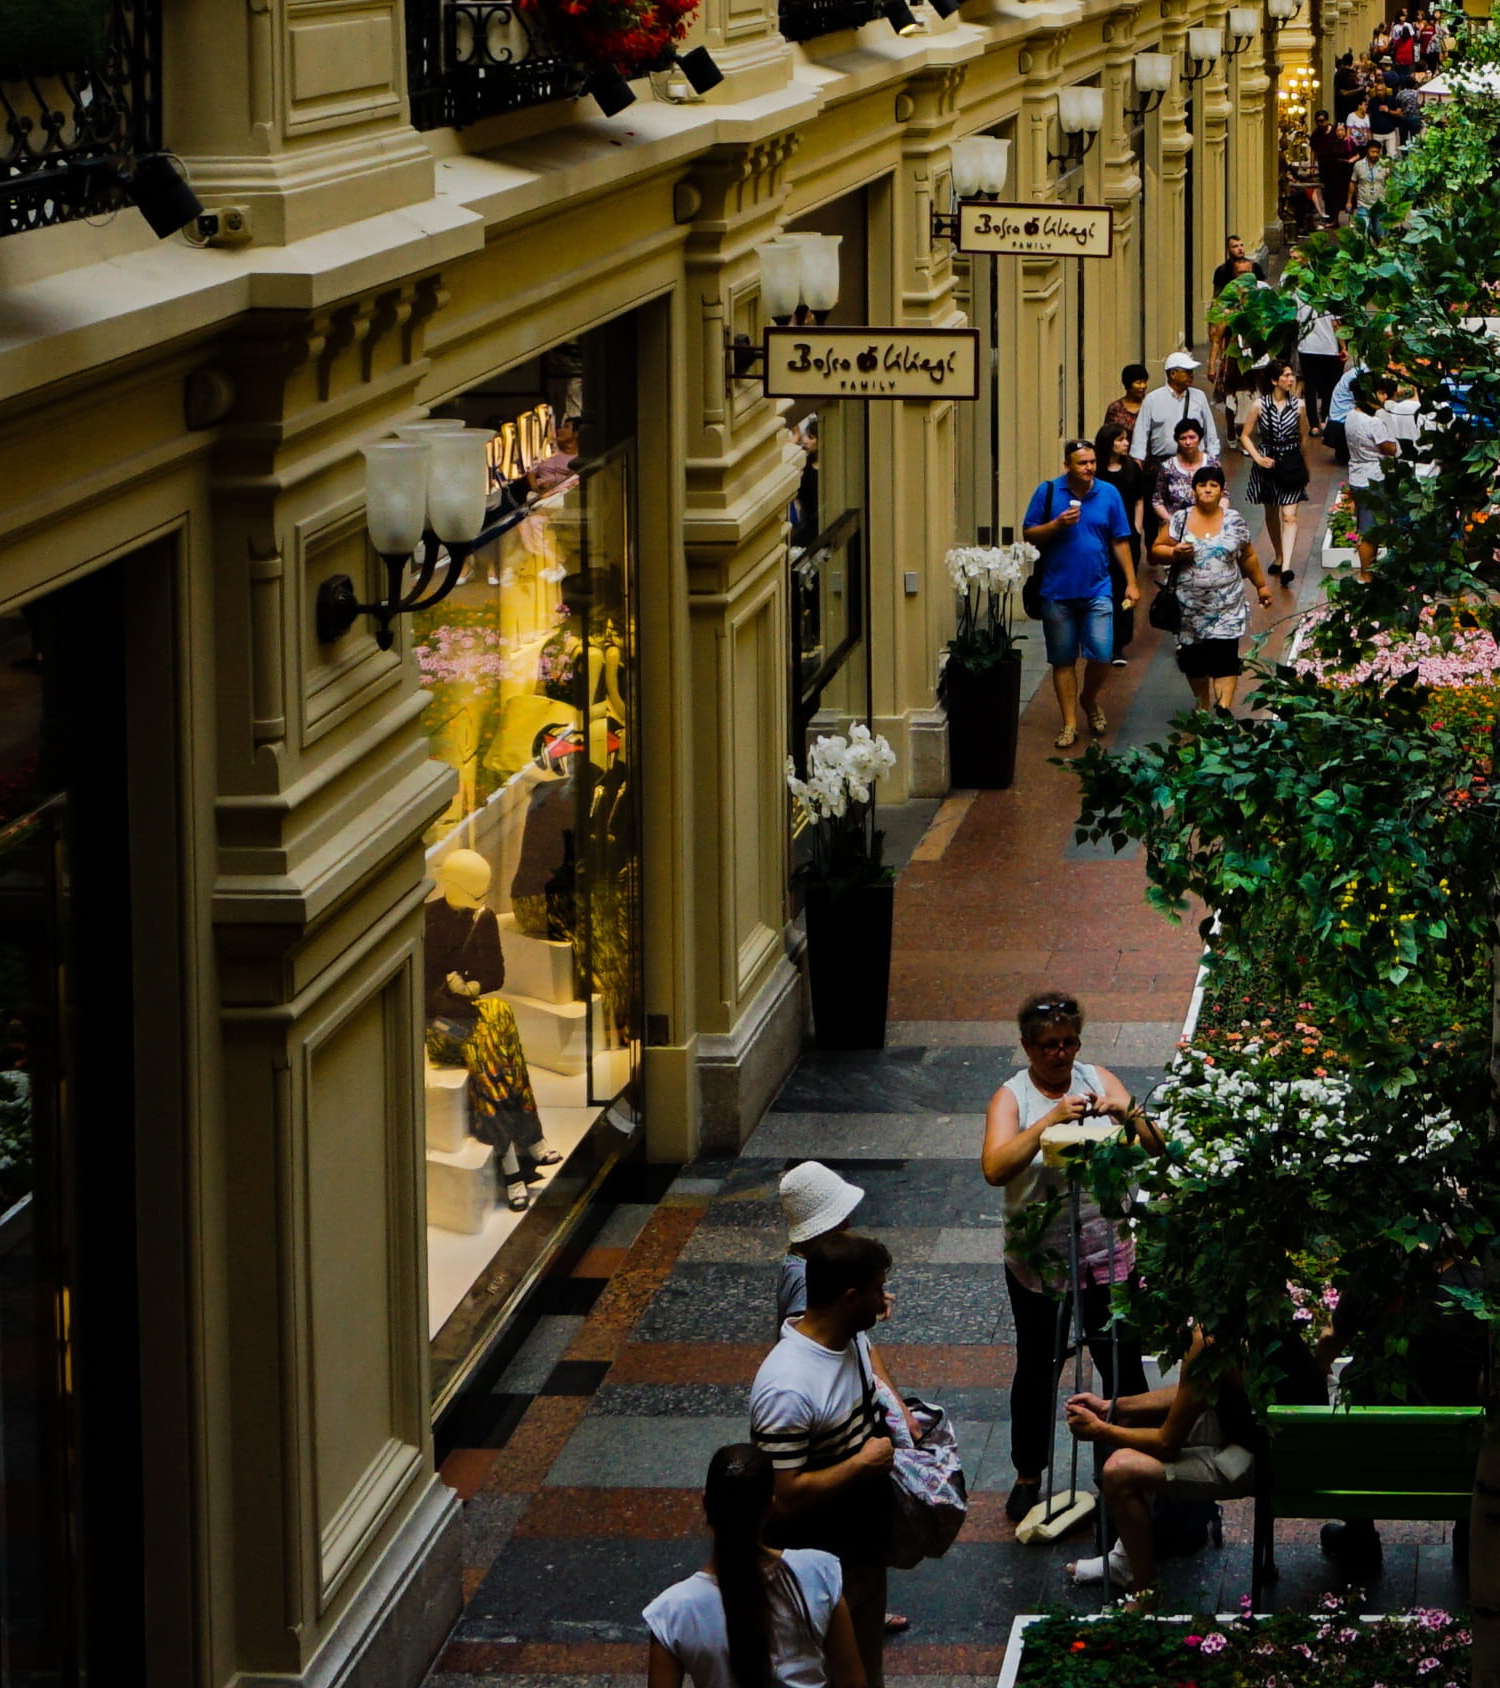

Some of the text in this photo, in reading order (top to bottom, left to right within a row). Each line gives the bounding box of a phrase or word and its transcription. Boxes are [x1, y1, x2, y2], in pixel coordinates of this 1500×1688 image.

[975, 214, 1020, 239] Bosco
[1012, 241, 1052, 250] FAMILY
[788, 343, 850, 378] Bosco
[840, 380, 896, 391] FAMILY
[485, 402, 557, 494] RADA
